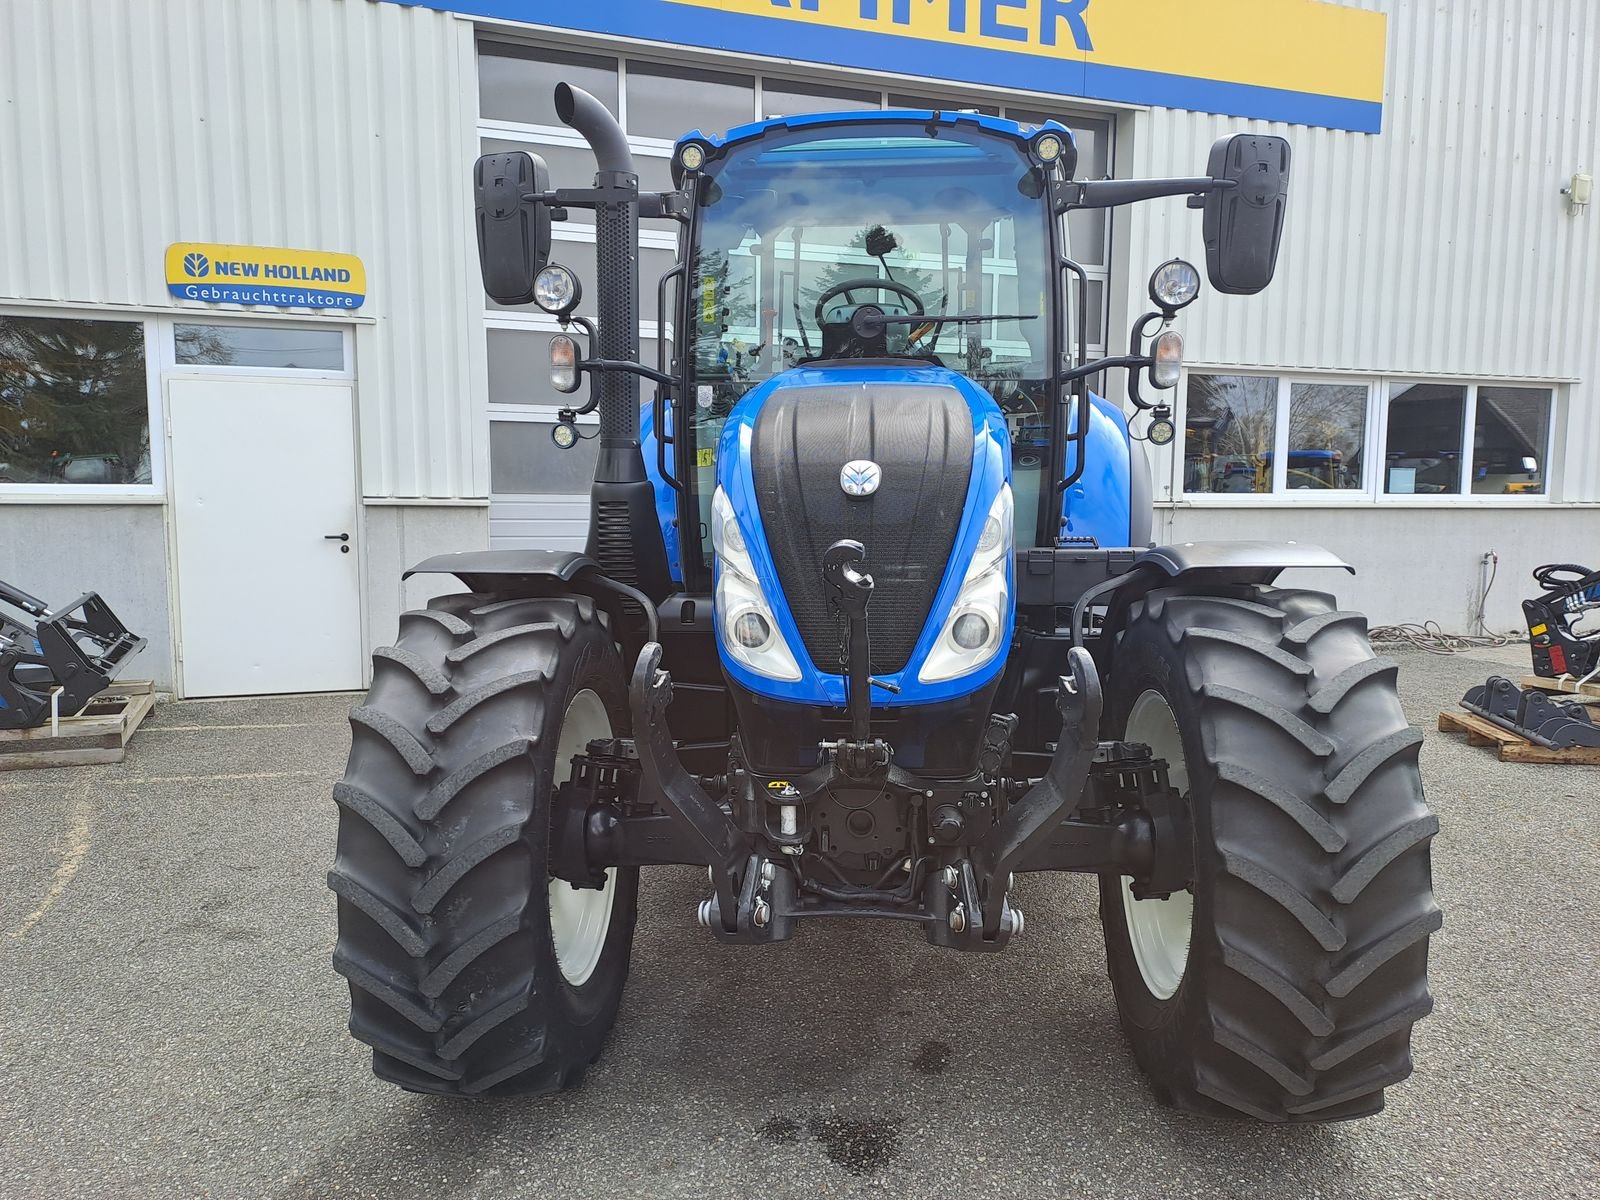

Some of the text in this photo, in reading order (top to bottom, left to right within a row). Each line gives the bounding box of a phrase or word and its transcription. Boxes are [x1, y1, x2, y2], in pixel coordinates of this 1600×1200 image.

[215, 261, 351, 283] NEW HOLLAND
[185, 284, 353, 306] Gebrauchttraktore
